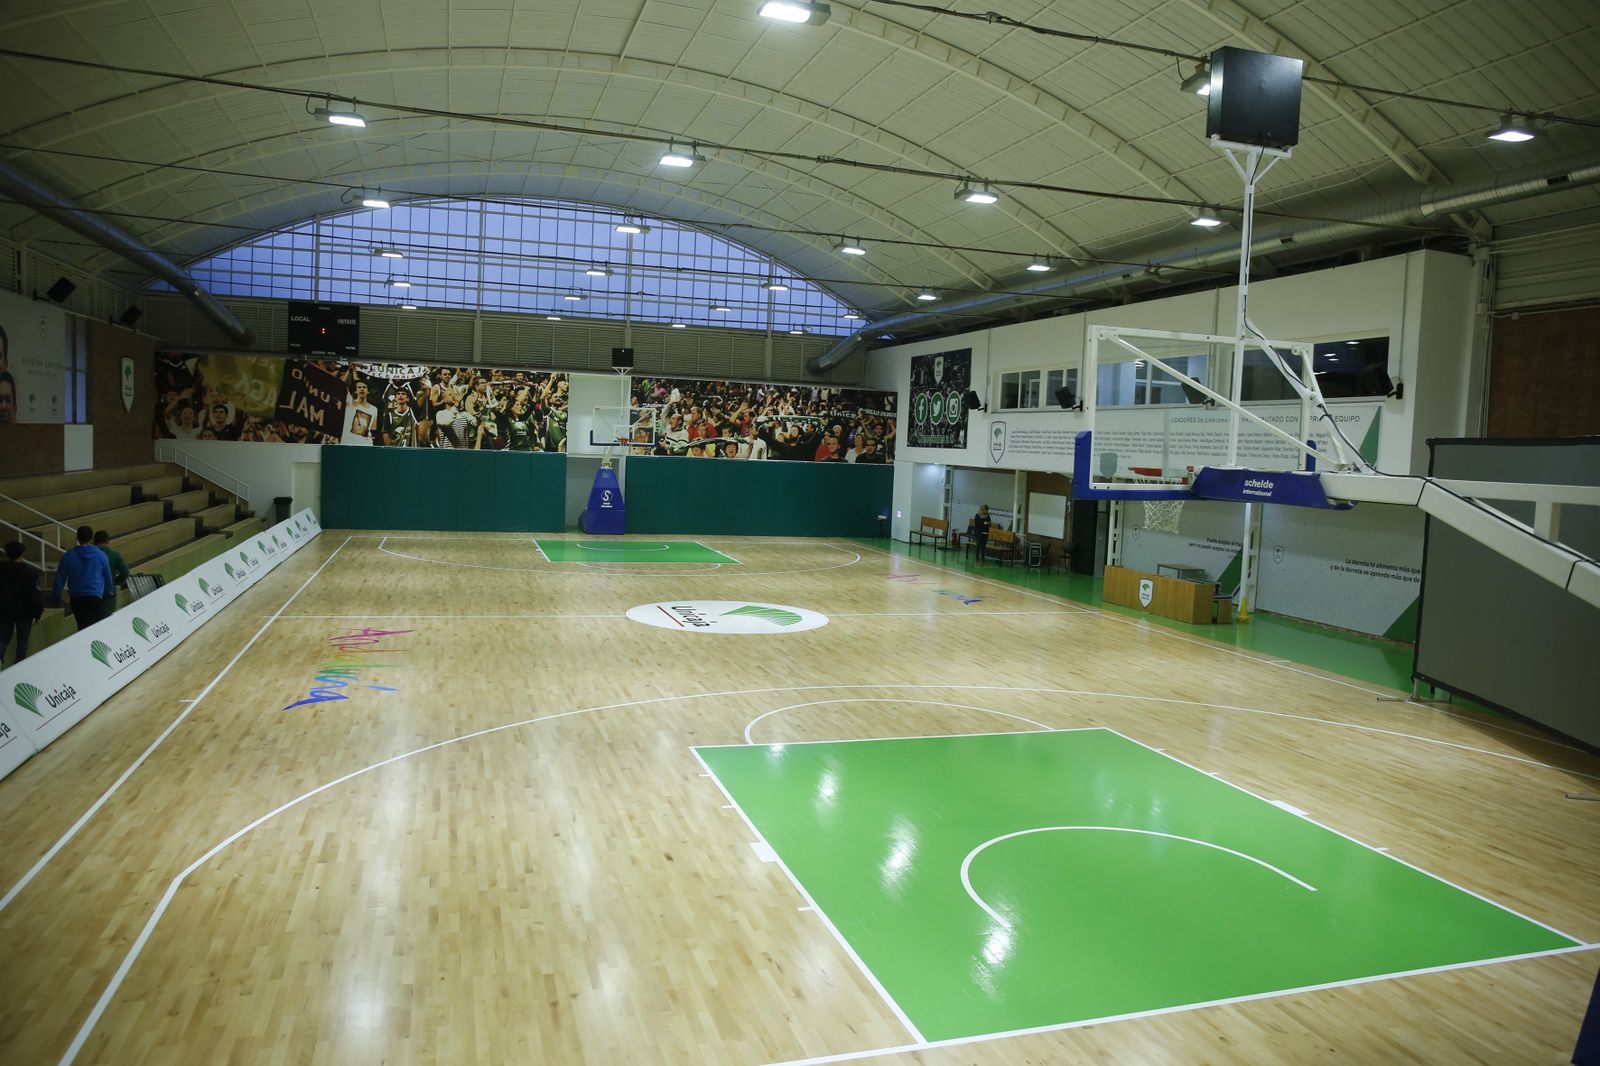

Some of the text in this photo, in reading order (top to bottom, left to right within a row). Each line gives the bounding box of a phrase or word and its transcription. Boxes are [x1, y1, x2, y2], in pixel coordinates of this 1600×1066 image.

[1285, 415, 1299, 423] CON
[1335, 415, 1360, 423] EQUIPO
[1244, 478, 1274, 489] schelde
[1242, 488, 1273, 497] international
[1345, 566, 1363, 575] derrota
[1370, 570, 1390, 578] aprende
[1391, 572, 1402, 580] más
[1402, 575, 1412, 583] que
[1352, 559, 1369, 567] derrota
[1376, 562, 1398, 571] alimenta
[1399, 565, 1410, 573] más
[671, 605, 718, 627] Unicaja
[151, 621, 170, 638] Unicaja
[113, 644, 137, 663] Unicaja
[45, 683, 77, 708] Unicaja
